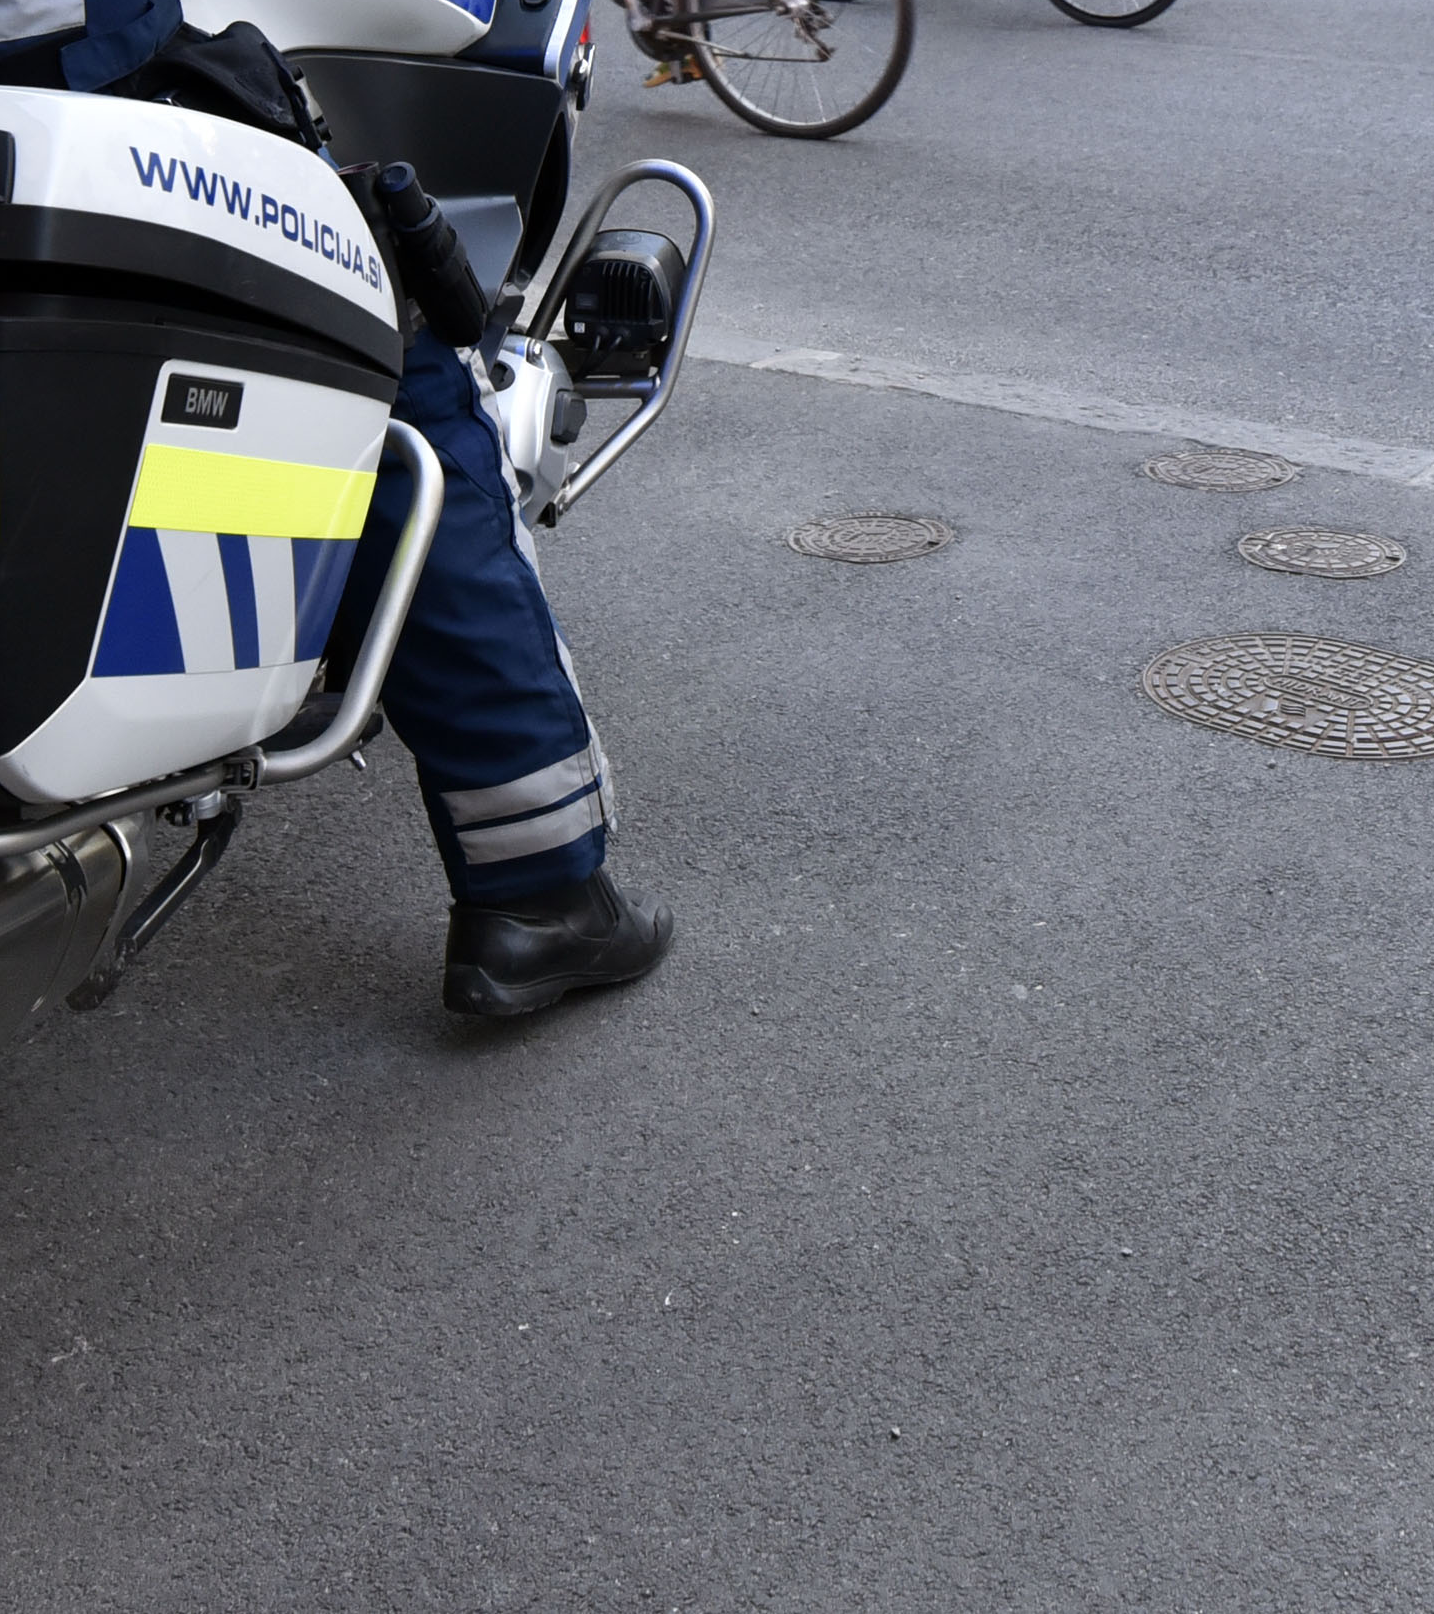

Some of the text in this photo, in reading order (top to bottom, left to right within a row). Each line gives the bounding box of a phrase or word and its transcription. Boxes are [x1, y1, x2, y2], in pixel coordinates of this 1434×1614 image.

[128, 145, 383, 294] WWW.POLICIJA.SI
[185, 387, 229, 418] BMW
[1272, 678, 1366, 707] HIDRANT
